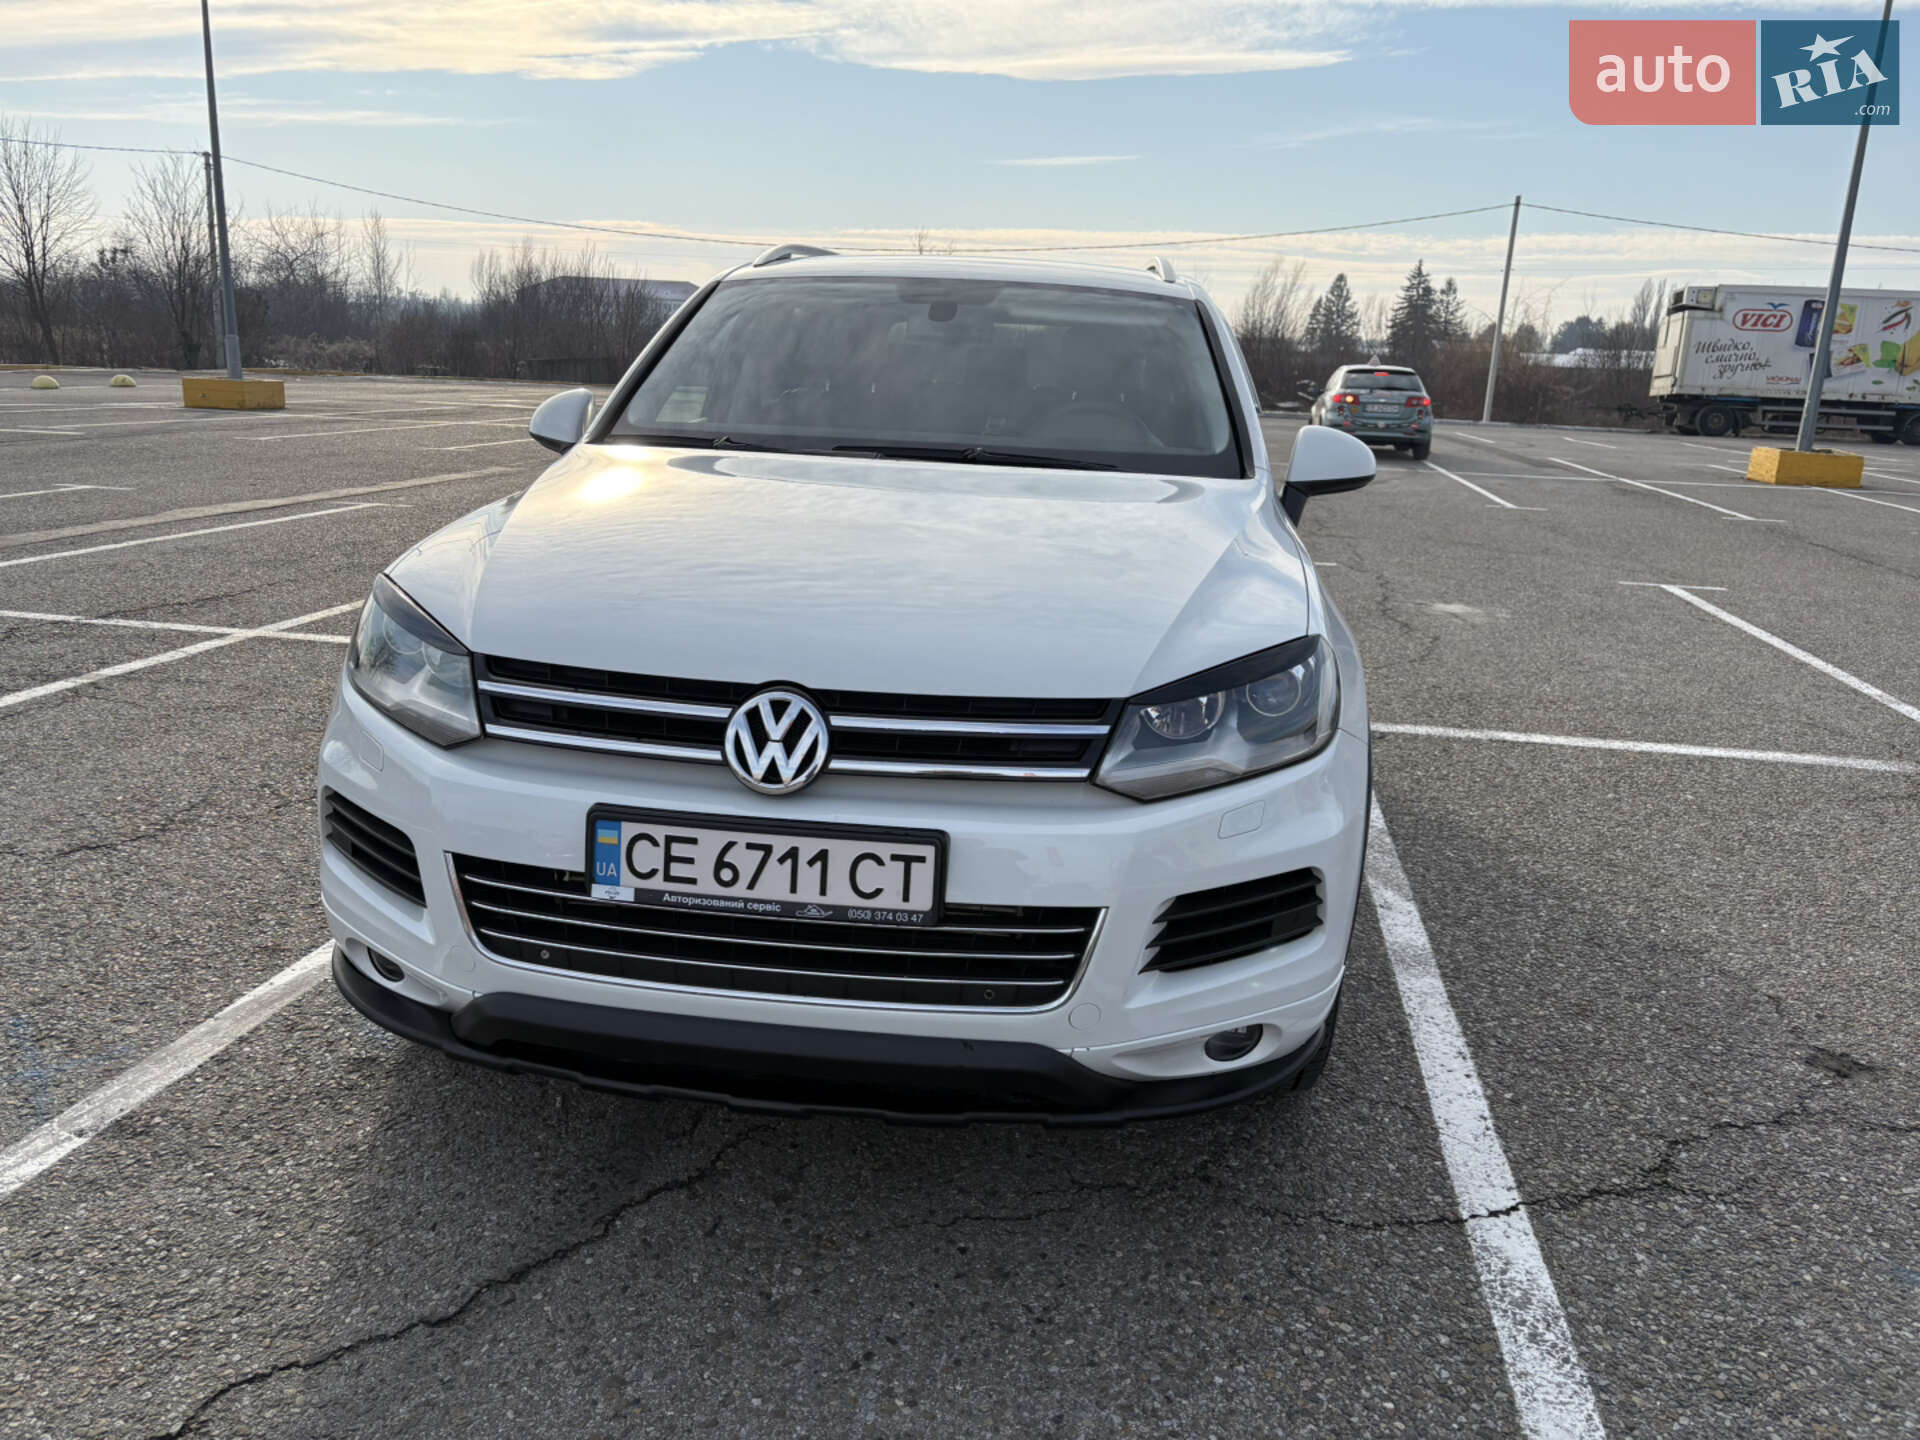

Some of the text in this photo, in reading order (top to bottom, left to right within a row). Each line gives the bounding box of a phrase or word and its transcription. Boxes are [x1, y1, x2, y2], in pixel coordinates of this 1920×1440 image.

[596, 860, 618, 878] UA
[625, 832, 926, 903] CE 6711 CT
[663, 892, 782, 913] Авторизований сервіс
[847, 908, 924, 923] (050) 374 03 47
